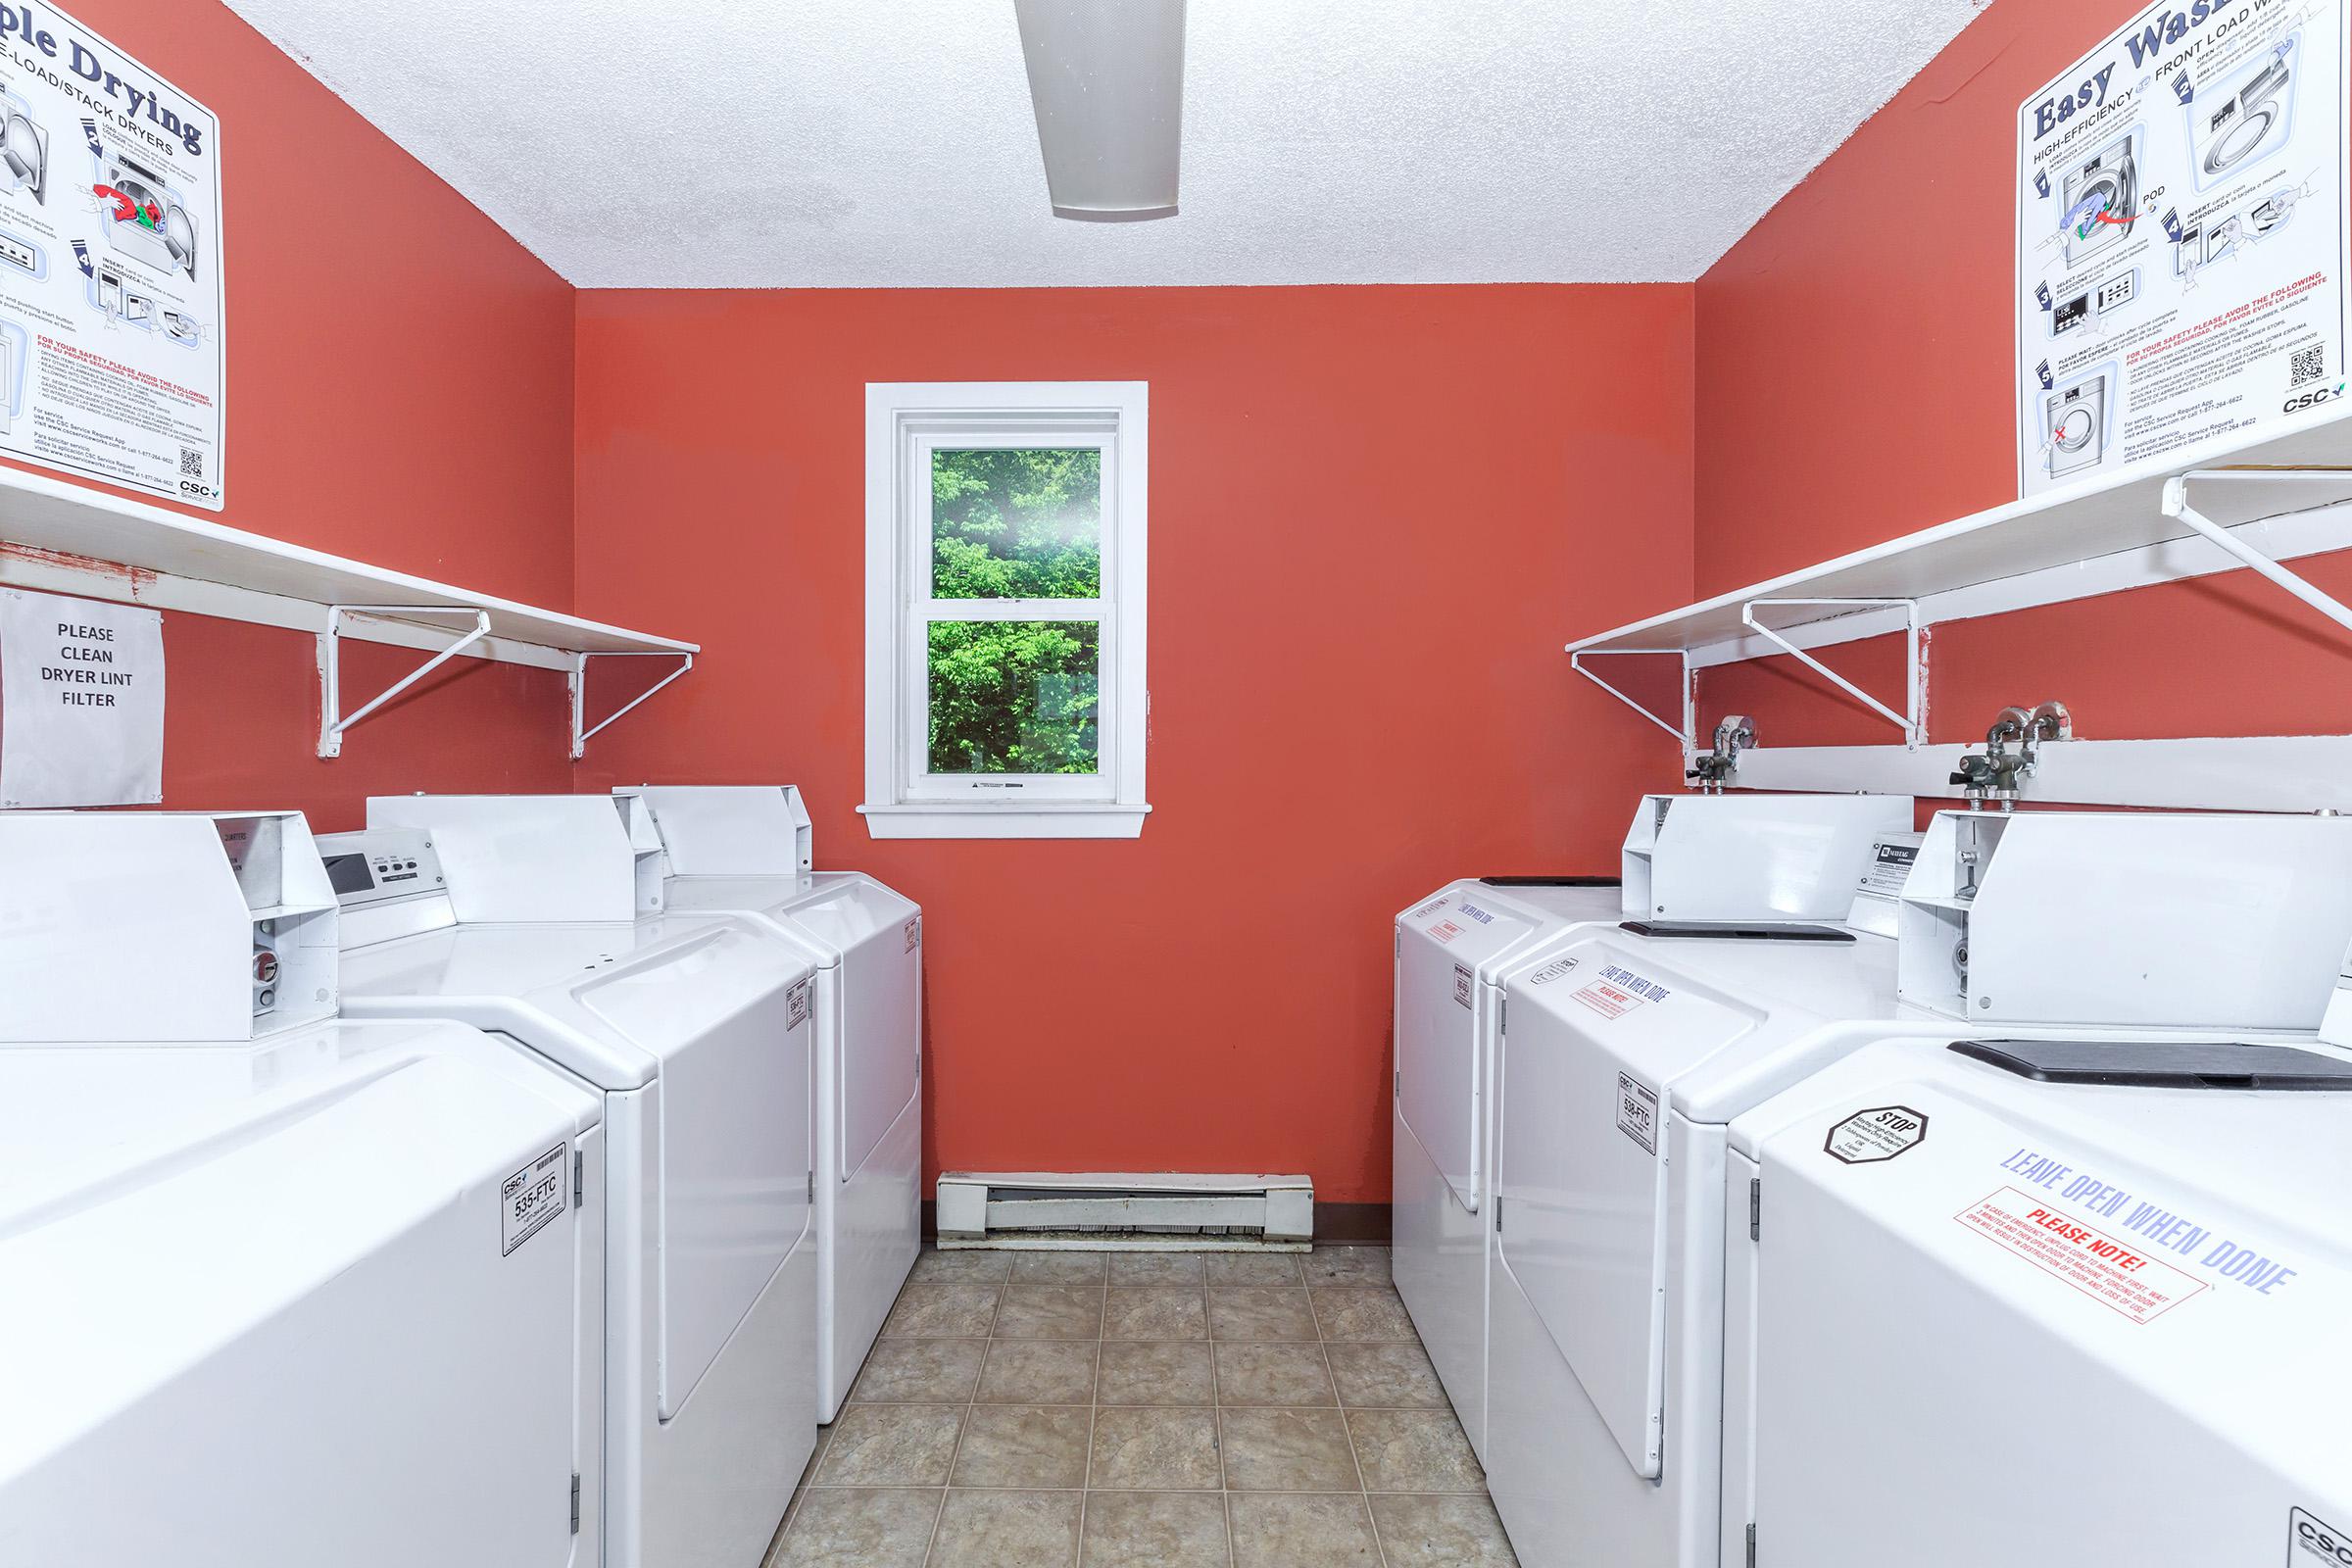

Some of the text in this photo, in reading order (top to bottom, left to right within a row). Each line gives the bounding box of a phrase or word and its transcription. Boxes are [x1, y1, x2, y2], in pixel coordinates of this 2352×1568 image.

[2155, 6, 2249, 80] FRONT LOAD
[2196, 47, 2214, 64] OPEN
[2034, 62, 2116, 141] Easy
[2125, 0, 2232, 69] Was
[69, 38, 202, 156] Drying
[2179, 82, 2190, 97] 2
[88, 132, 98, 145] 2
[119, 116, 172, 156] DRYERS
[2034, 88, 2133, 164] HIGH-EFFICIENCY
[2142, 184, 2164, 205] POD
[2187, 199, 2229, 225] INTRODUZCA
[2237, 184, 2255, 198] tarjeta
[2262, 169, 2285, 185] moneda
[2187, 202, 2210, 219] INSERT
[2212, 194, 2224, 205] card
[2232, 183, 2245, 194] coin
[2168, 222, 2179, 234] 4
[79, 255, 89, 265] 4
[102, 256, 123, 270] INSERT
[102, 262, 140, 284] INTRODUZCA
[2056, 275, 2075, 289] SELECT
[2056, 274, 2087, 295] SELECCIONE
[2040, 292, 2049, 305] 3
[2126, 270, 2321, 360] FOR YOUR SAFETY PLEASE AVOID THE FOLLOWING
[2126, 357, 2138, 366] POR
[2149, 342, 2172, 356] PROPIA
[2213, 318, 2227, 329] POR
[2229, 309, 2250, 322] FAVOR
[2252, 299, 2273, 313] EVITE
[2275, 294, 2284, 303] LO
[2286, 275, 2327, 298] SIGUIENTE
[37, 340, 52, 350] POR
[64, 350, 87, 363] PROPIA
[127, 372, 139, 381] POR
[140, 377, 158, 388] FAVOR
[160, 384, 174, 394] EVITE
[37, 333, 209, 402] FOR YOUR SAFETY PLEASE AVOID THE FOLLOWING
[2058, 346, 2091, 366] PLEASE WAIT
[2041, 368, 2051, 382] 5
[2143, 418, 2155, 427] CSC
[2156, 411, 2176, 422] Service
[2177, 403, 2200, 416] Request
[2201, 398, 2213, 407] App
[2282, 387, 2328, 414] CSC
[2124, 431, 2134, 440] visit
[2187, 410, 2197, 418] call
[2199, 394, 2242, 415] 1-877-264-6622
[2134, 413, 2152, 424] service
[2124, 448, 2138, 459] utilice
[2174, 433, 2185, 442] CSC
[2187, 425, 2208, 438] Service
[2209, 417, 2233, 430] Request
[2124, 428, 2180, 452] Para solicitar servicio
[2124, 455, 2136, 465] visite
[2188, 434, 2203, 444] llame
[179, 479, 209, 496] CSC
[58, 623, 115, 643] PLEASE
[61, 646, 113, 663] CLEAN
[41, 667, 133, 687] DRYER LINT
[63, 692, 116, 708] FILTER
[1644, 984, 1671, 1003] DONE
[1623, 1098, 1650, 1126] 538-FTC
[1876, 1111, 1918, 1132] STOP
[504, 1176, 521, 1195] CSC
[514, 1176, 557, 1217] 535-FTC
[2000, 1149, 2298, 1296] LEAVE OPEN WHEN DONE
[2025, 1207, 2148, 1272] PLEASE NOTE!
[1965, 1213, 1983, 1223] OPEN
[1979, 1220, 1996, 1231] WILL
[1991, 1228, 2016, 1242] RESULT
[2019, 1243, 2062, 1267] DESTRUCTION
[2067, 1269, 2089, 1282] DOOR
[2085, 1279, 2104, 1290] AND
[2099, 1287, 2122, 1299] LOSS
[2118, 1297, 2132, 1305] OF
[1979, 1211, 2006, 1226] MINUTES
[2002, 1223, 2018, 1233] AND
[2013, 1230, 2034, 1241] THEN
[2029, 1238, 2049, 1250] OPEN
[2044, 1247, 2067, 1258] DOOR
[2102, 1277, 2135, 1297] FORCING
[2132, 1293, 2157, 1307] DOOR
[1987, 1205, 2006, 1216] CASE
[2043, 1236, 2072, 1251] UNPLUG
[2067, 1248, 2090, 1260] CORD
[2094, 1262, 2130, 1282] MACHINE
[2146, 1290, 2170, 1303] WAIT
[2297, 1521, 2352, 1565] CSC
